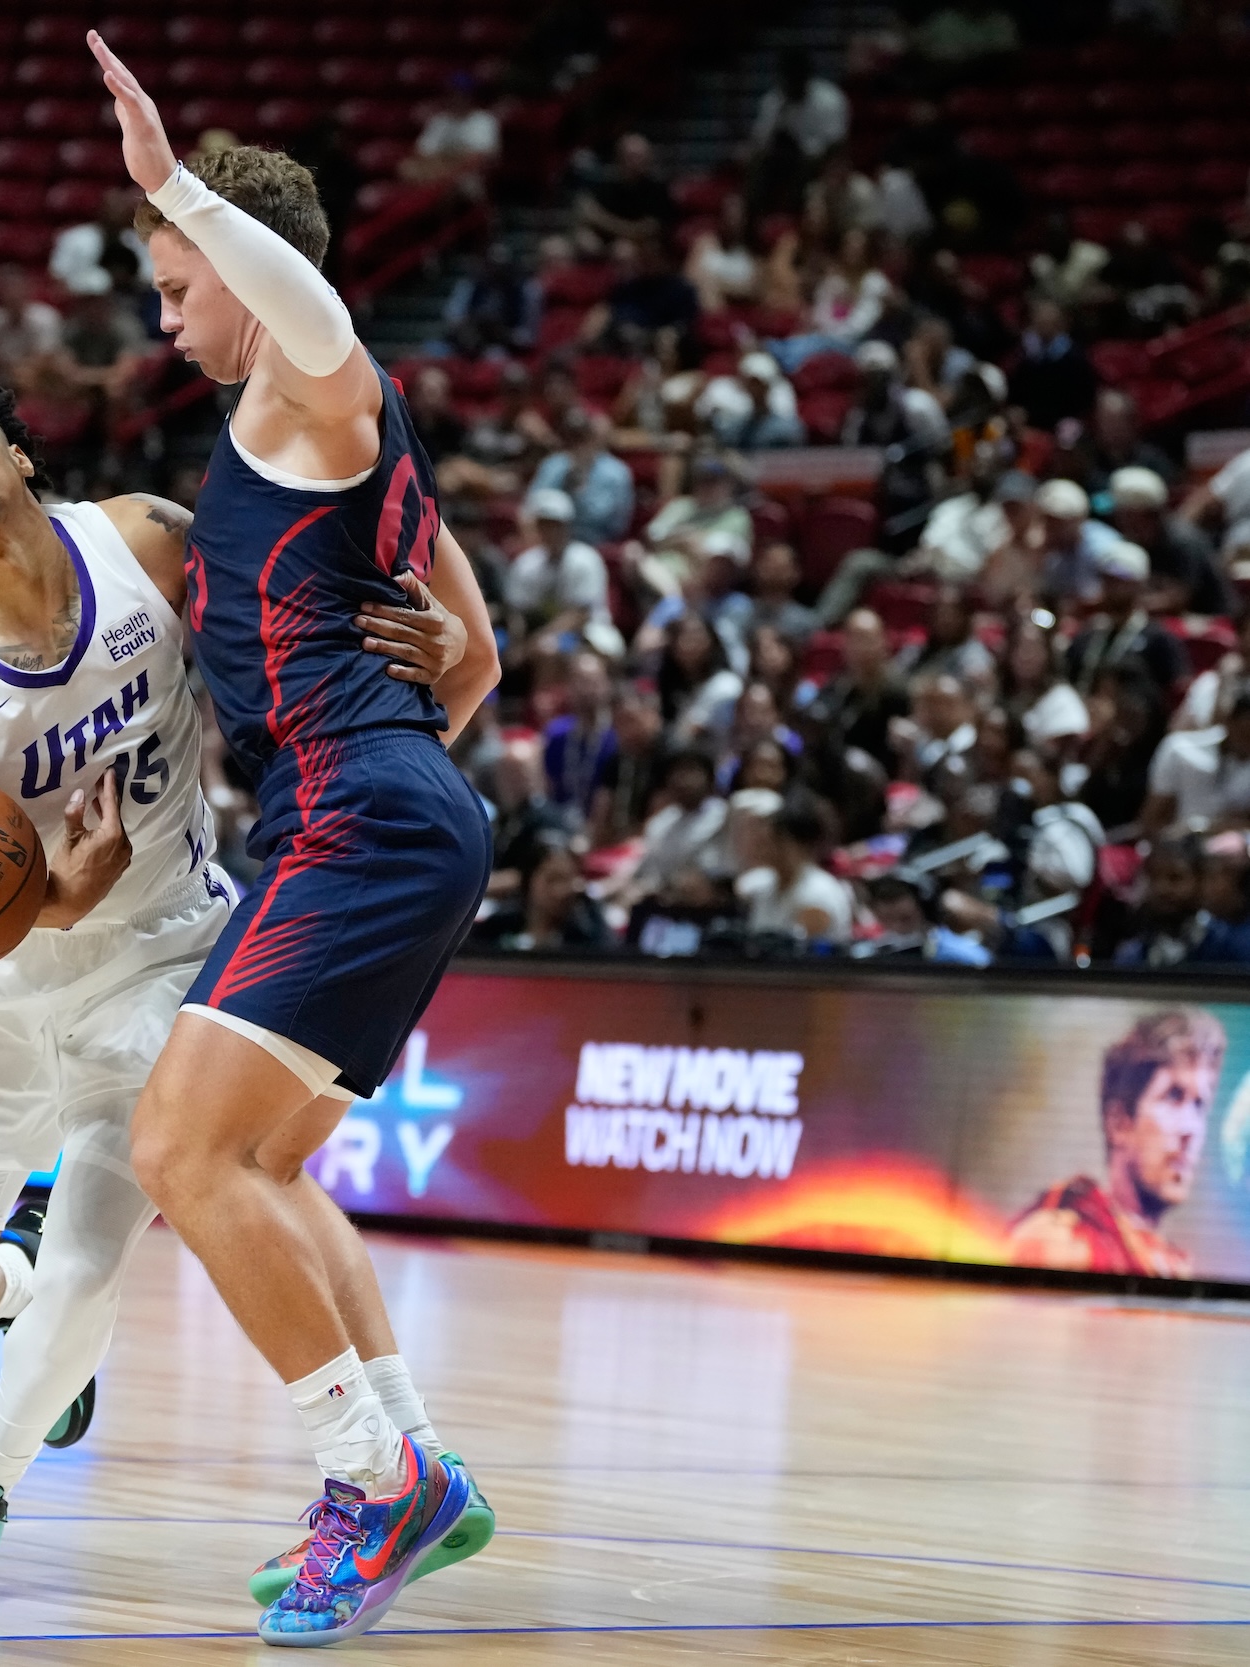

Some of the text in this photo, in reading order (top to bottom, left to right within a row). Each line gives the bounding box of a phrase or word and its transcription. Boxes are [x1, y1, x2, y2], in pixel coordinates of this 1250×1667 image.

[101, 611, 150, 648] Health
[109, 626, 156, 662] Equity
[20, 668, 150, 799] UTAH
[576, 1042, 804, 1116] NEW MOVIE
[565, 1104, 803, 1180] WATCH NOW
